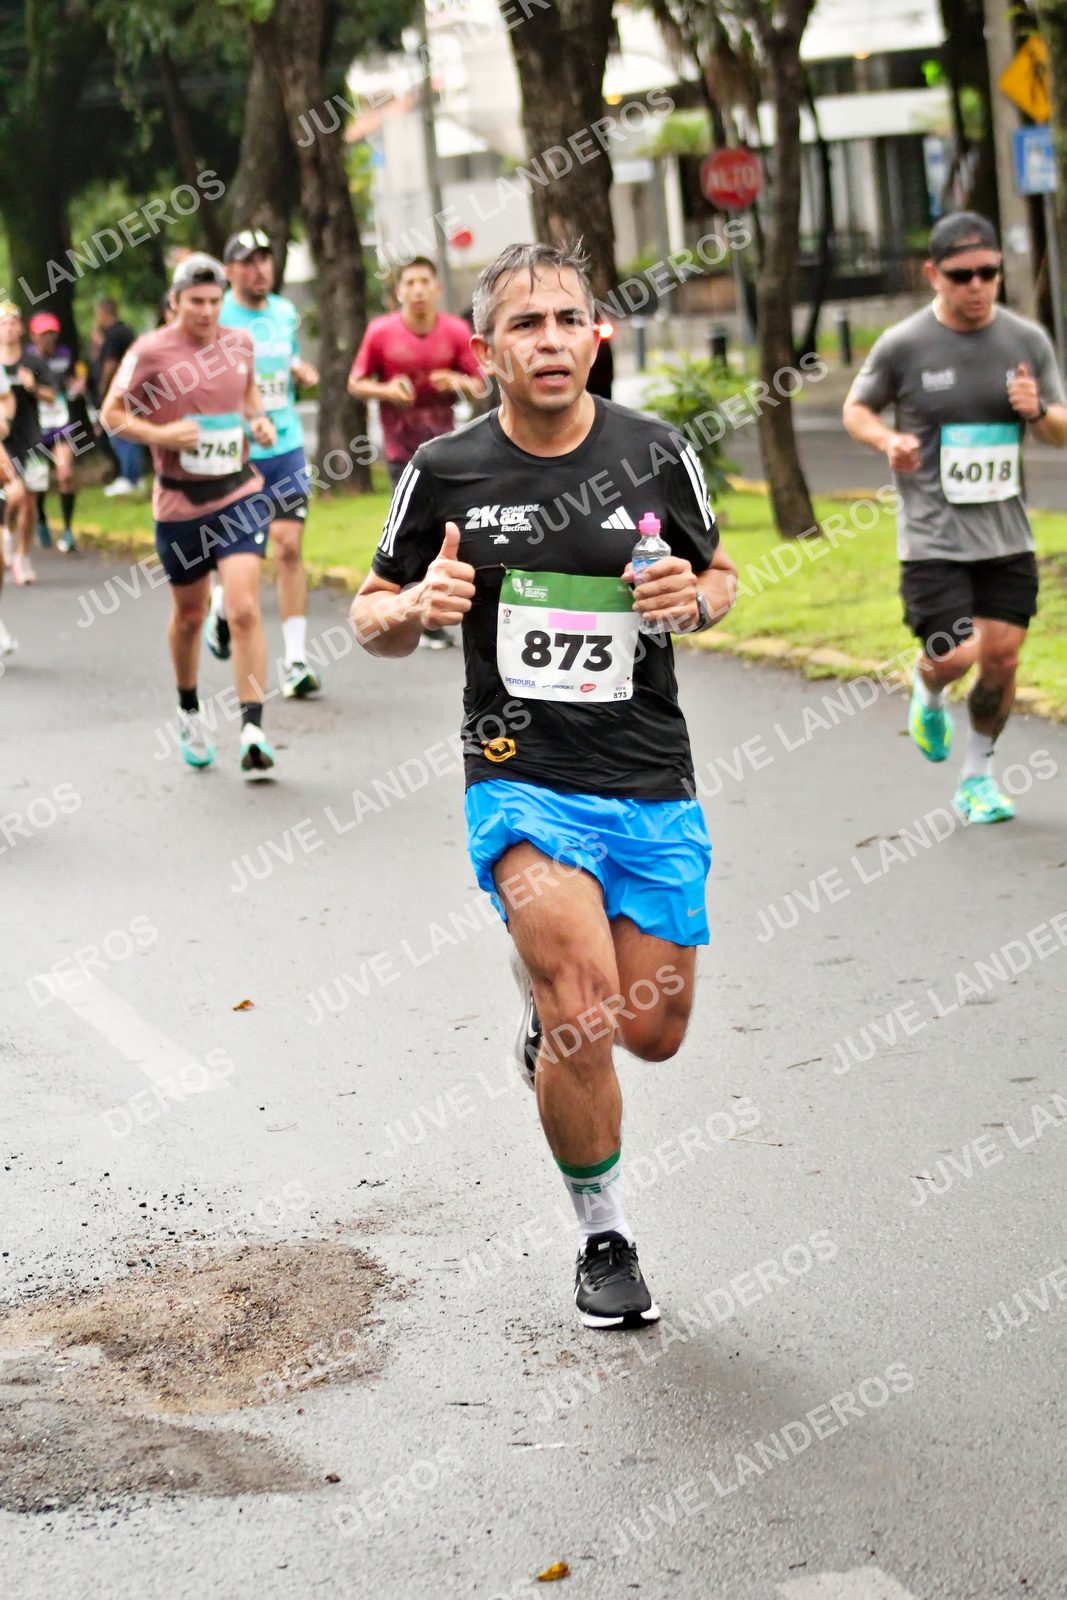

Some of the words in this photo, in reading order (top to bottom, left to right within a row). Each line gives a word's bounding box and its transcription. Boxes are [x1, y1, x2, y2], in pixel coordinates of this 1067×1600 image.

[707, 165, 758, 190] ALTO
[948, 461, 1012, 482] 4018
[521, 630, 613, 672] 873
[505, 677, 536, 687] PERDURA
[613, 691, 628, 699] 873
